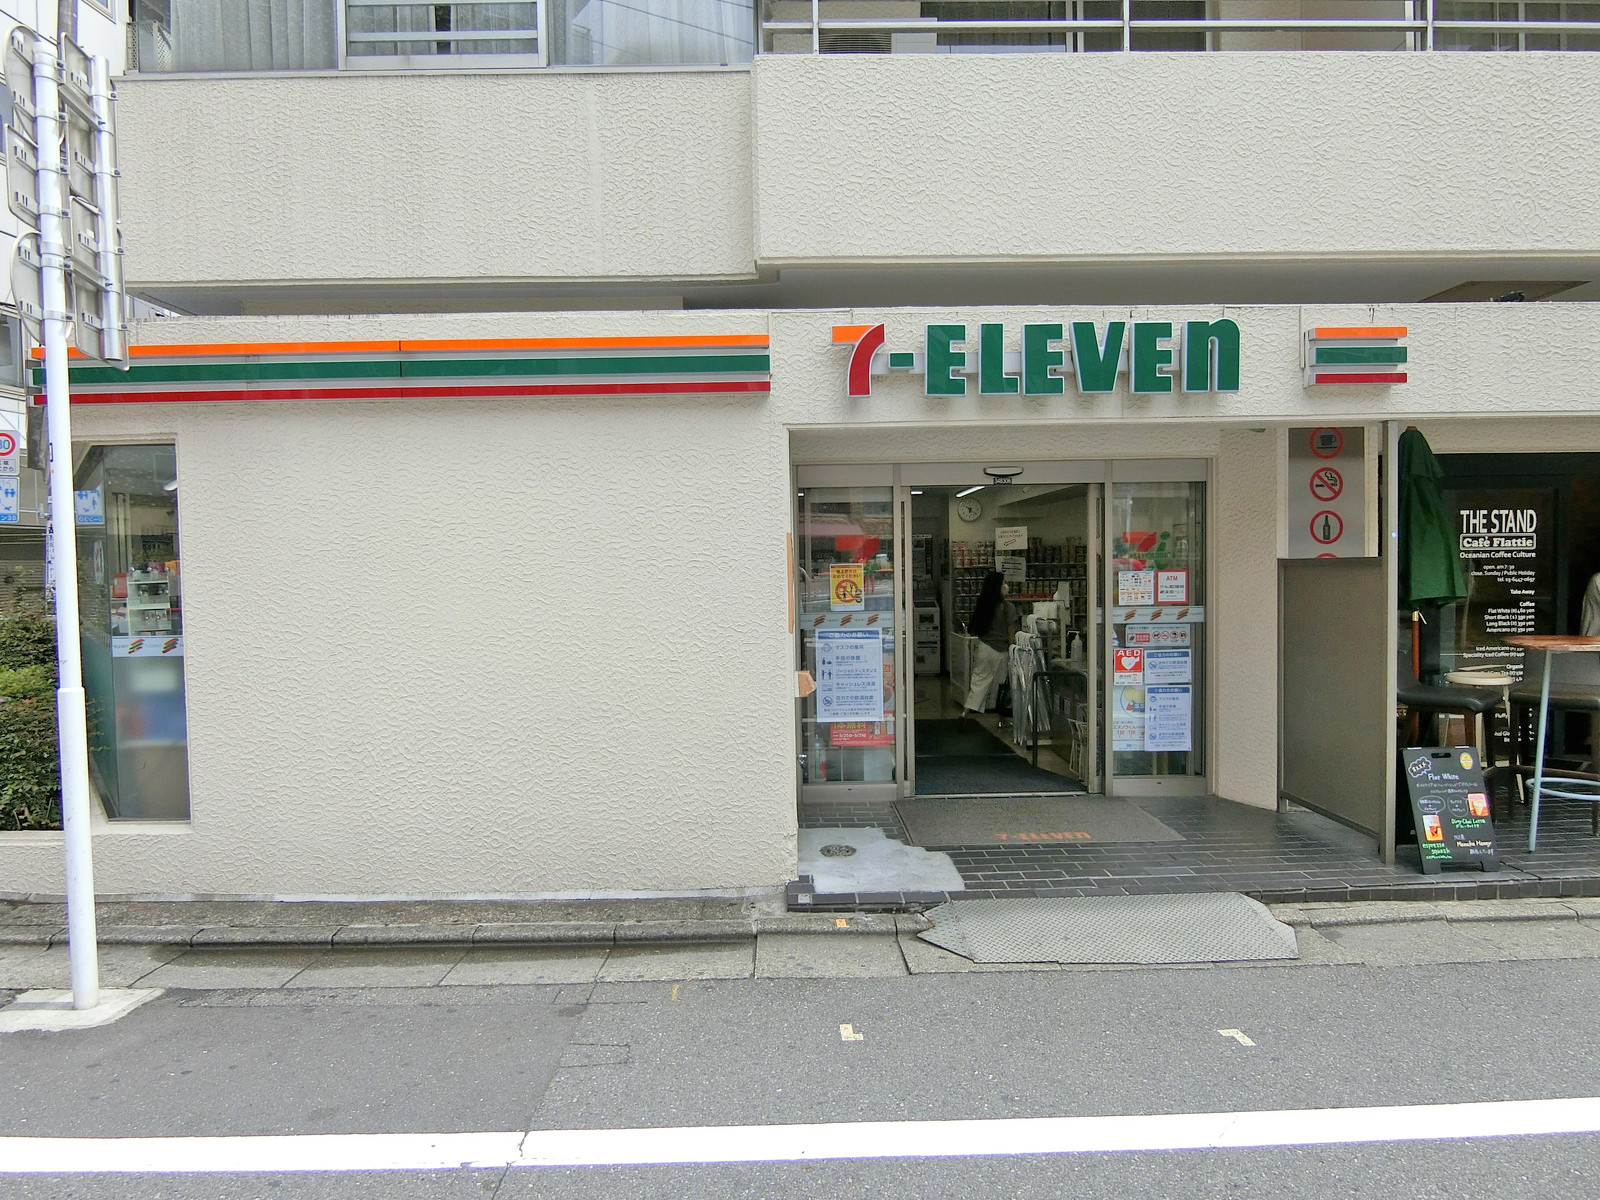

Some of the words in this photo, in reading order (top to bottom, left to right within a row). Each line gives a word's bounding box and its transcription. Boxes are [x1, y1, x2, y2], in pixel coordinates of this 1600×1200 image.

[1460, 509, 1488, 534] THE
[1490, 509, 1537, 533] STAND
[1492, 537, 1533, 548] Flattie
